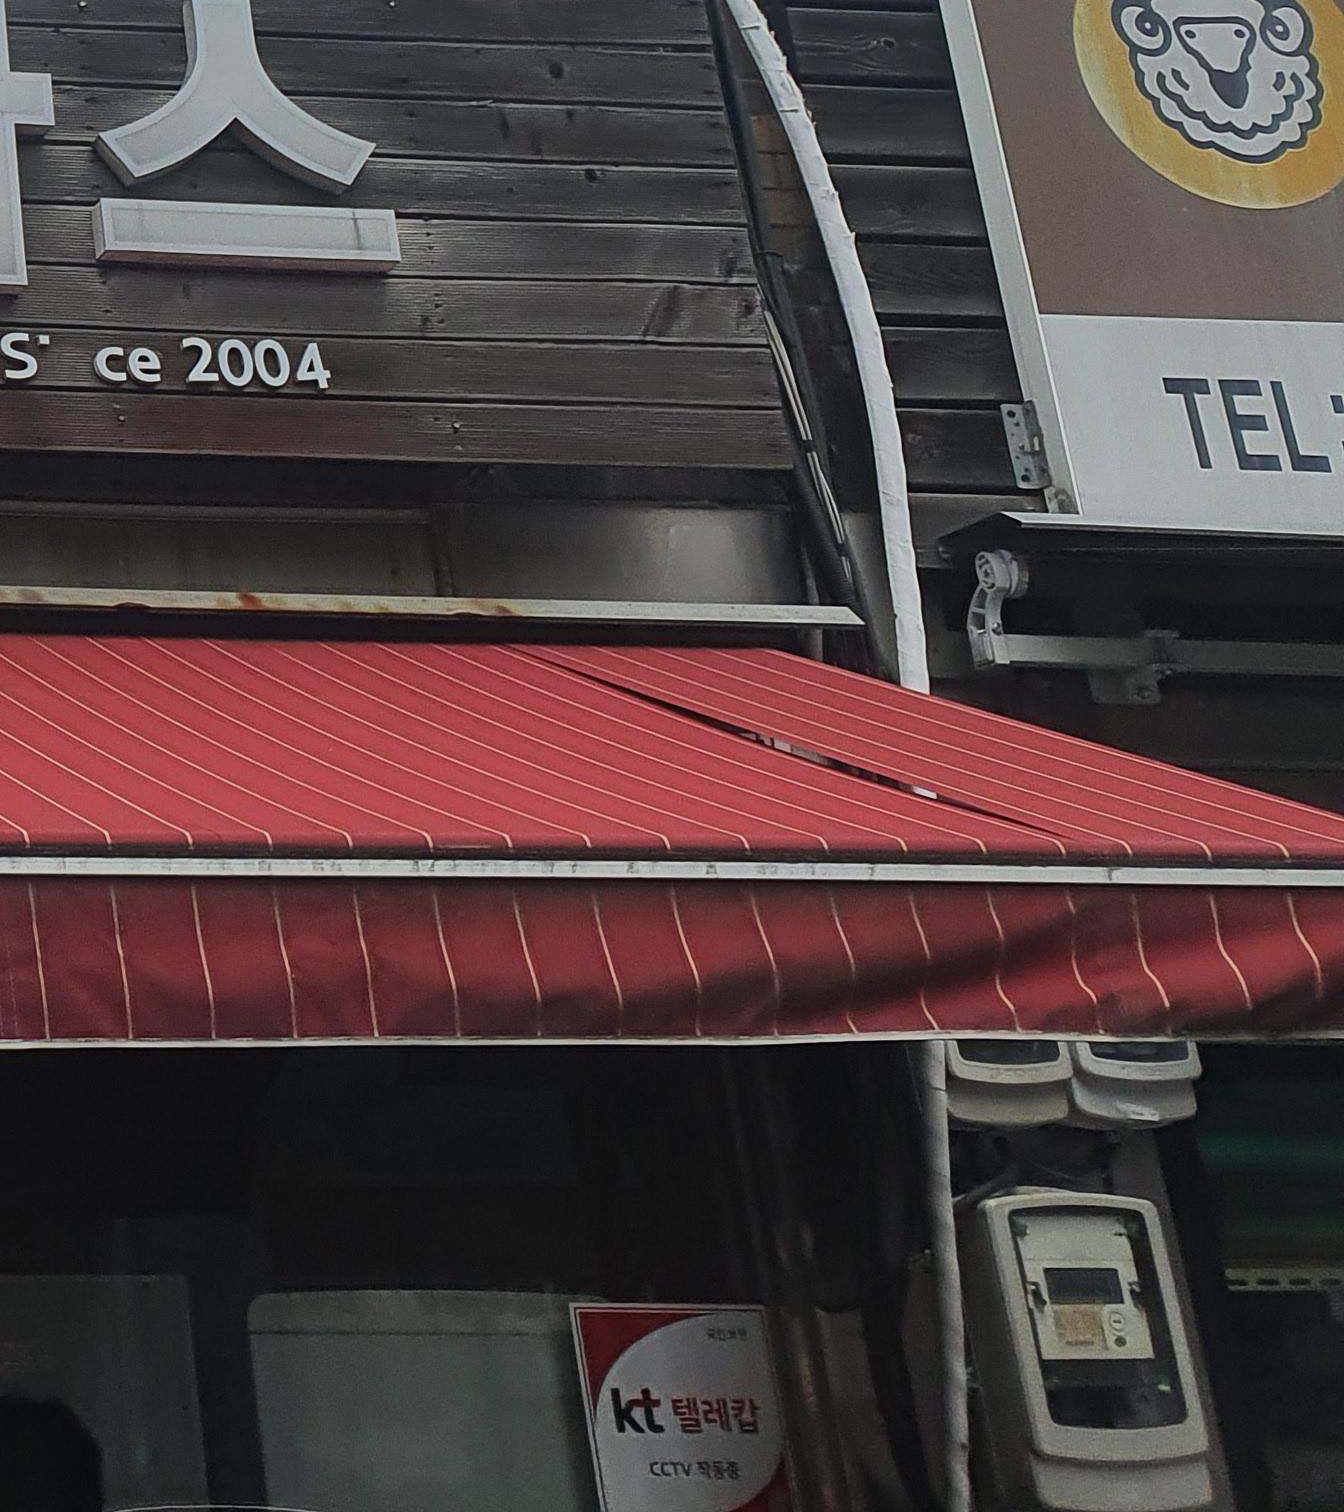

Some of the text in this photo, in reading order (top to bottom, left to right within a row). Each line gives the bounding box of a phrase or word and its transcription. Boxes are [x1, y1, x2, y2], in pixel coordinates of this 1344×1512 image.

[0, 332, 332, 389] Sce 2004
[610, 1387, 761, 1434] kt 텔레캅
[649, 1461, 692, 1478] CCTV
